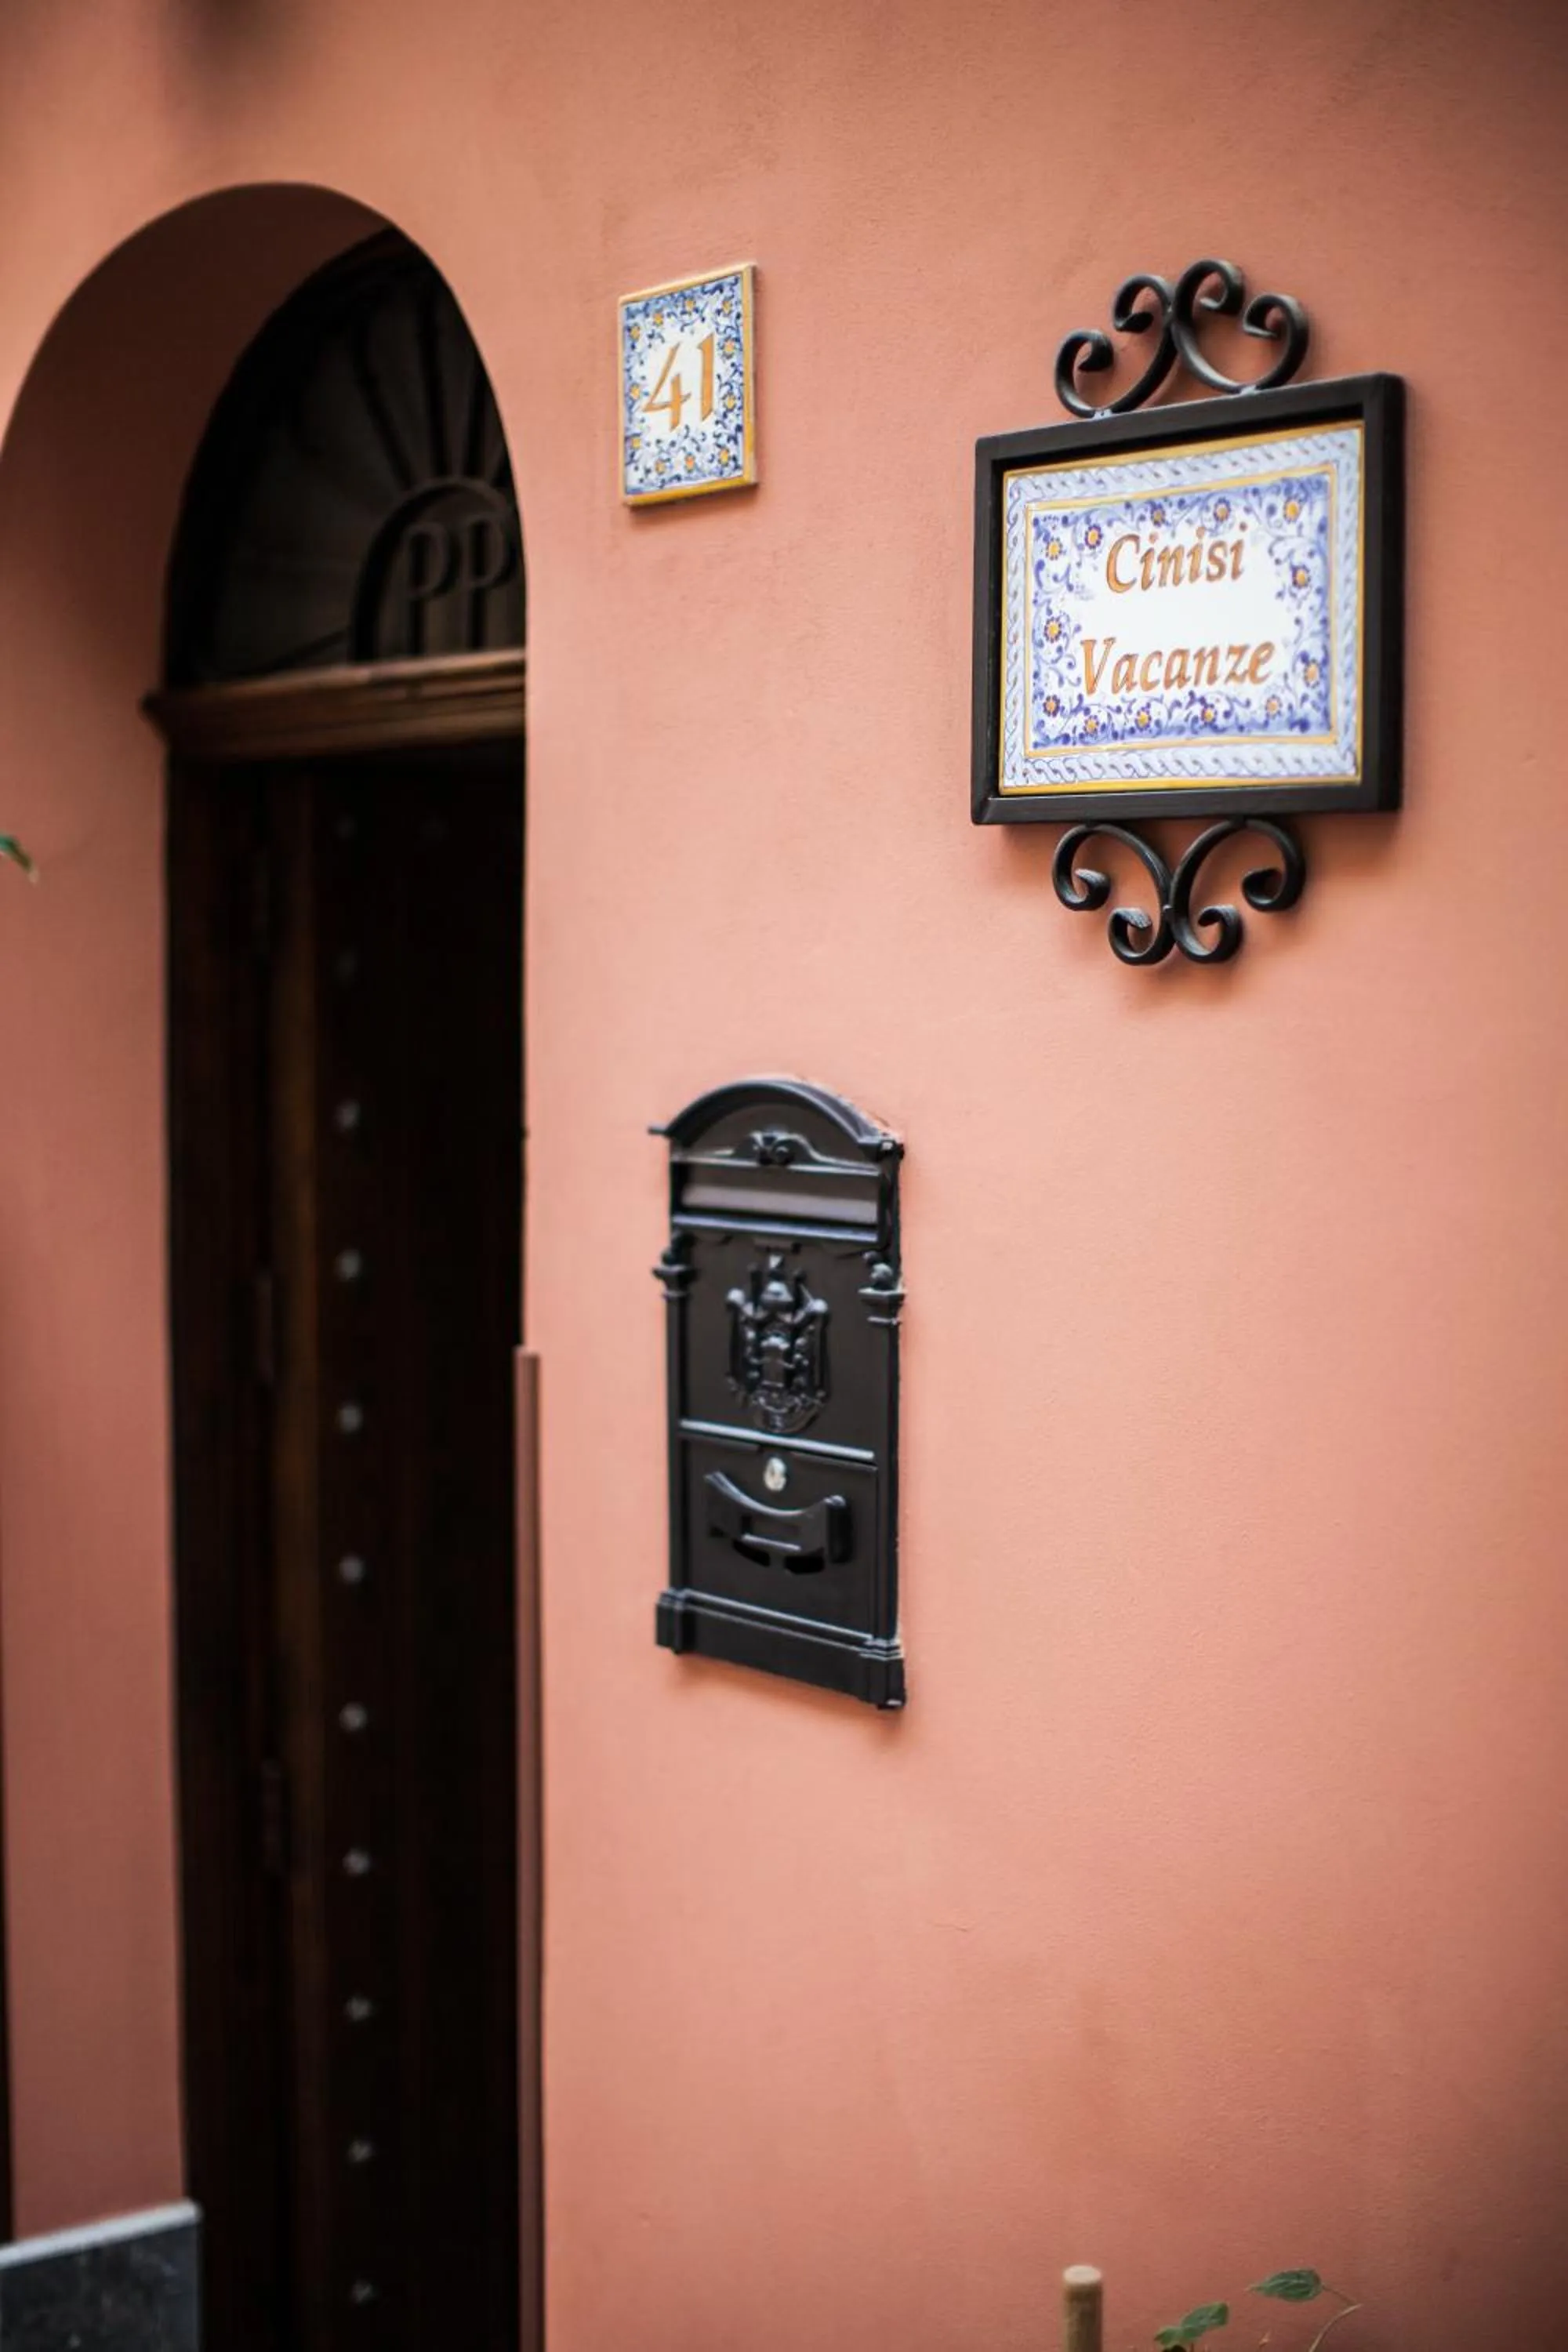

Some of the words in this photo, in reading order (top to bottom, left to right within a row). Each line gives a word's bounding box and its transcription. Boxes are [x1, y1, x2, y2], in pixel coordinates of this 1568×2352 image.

[642, 332, 714, 432] 41
[1106, 522, 1248, 593] Cinisi
[1080, 637, 1276, 695] Vacanze
